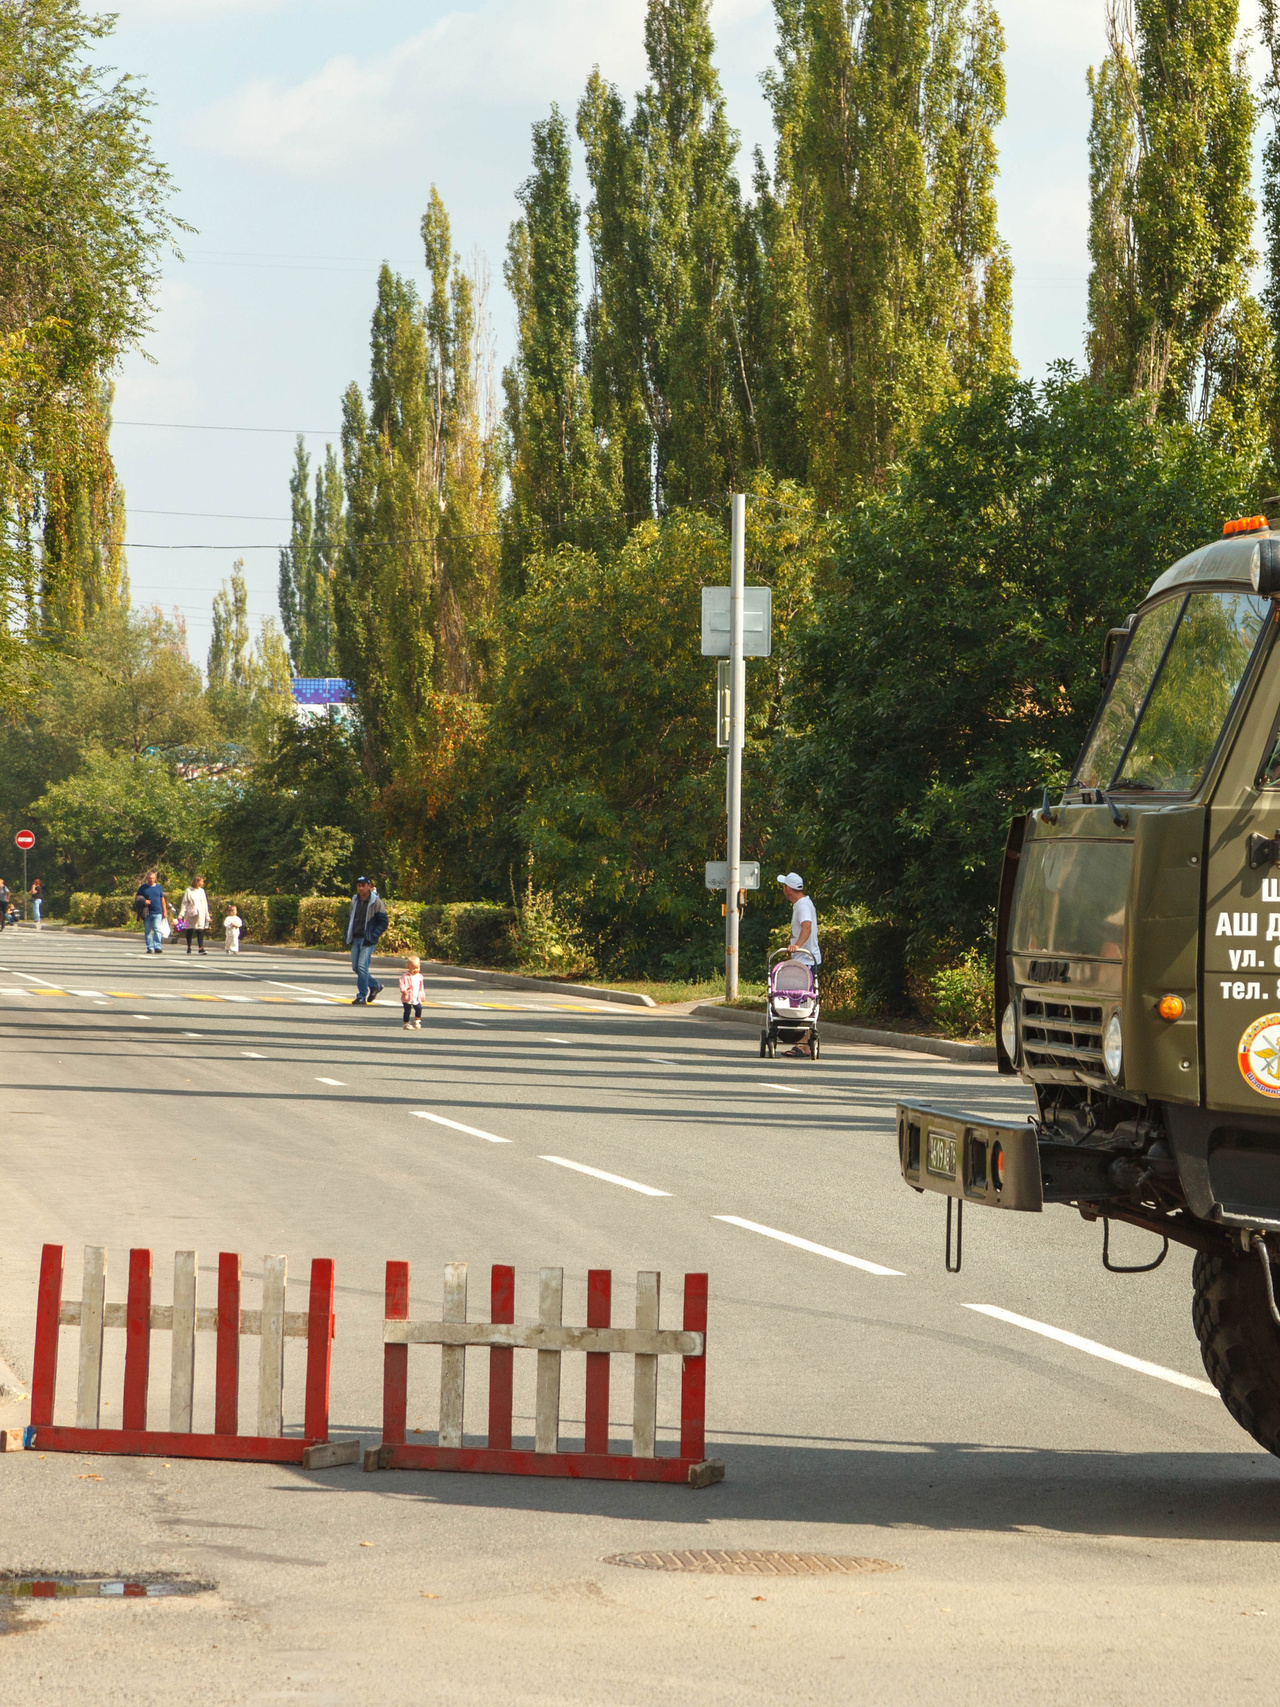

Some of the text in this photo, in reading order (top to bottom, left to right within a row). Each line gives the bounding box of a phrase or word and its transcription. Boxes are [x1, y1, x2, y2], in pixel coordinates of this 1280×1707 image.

[1215, 912, 1258, 937] АШ
[1228, 949, 1265, 971] ул.
[1219, 981, 1269, 1000] тел.
[1242, 1015, 1280, 1049] ДОСААФ
